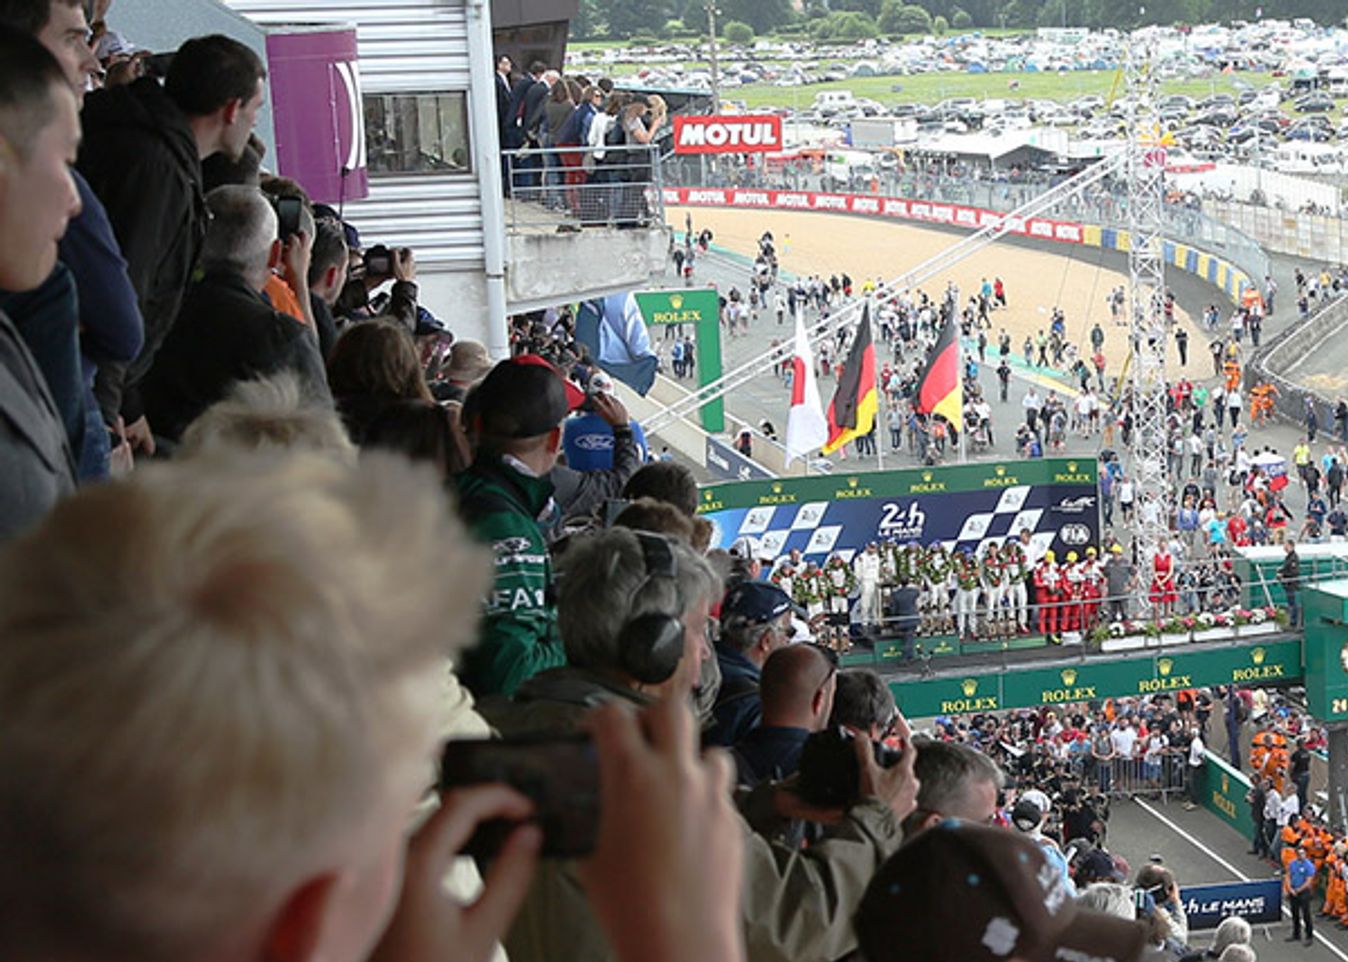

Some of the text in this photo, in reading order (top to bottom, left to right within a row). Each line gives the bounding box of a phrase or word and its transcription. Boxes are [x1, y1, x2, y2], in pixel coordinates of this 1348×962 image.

[679, 122, 777, 145] MOTUL
[653, 310, 702, 323] ROLEX
[984, 475, 1019, 487] ROLEX
[1055, 472, 1091, 483] ROLEX
[835, 488, 872, 499] ROLEX
[910, 482, 946, 493] ROLEX
[1232, 664, 1284, 681] ROLEX
[1138, 675, 1192, 693] ROLEX
[1041, 686, 1096, 703] ROLEX
[941, 696, 997, 713] ROLEX
[1201, 900, 1221, 914] LE
[1222, 896, 1265, 910] MANS
